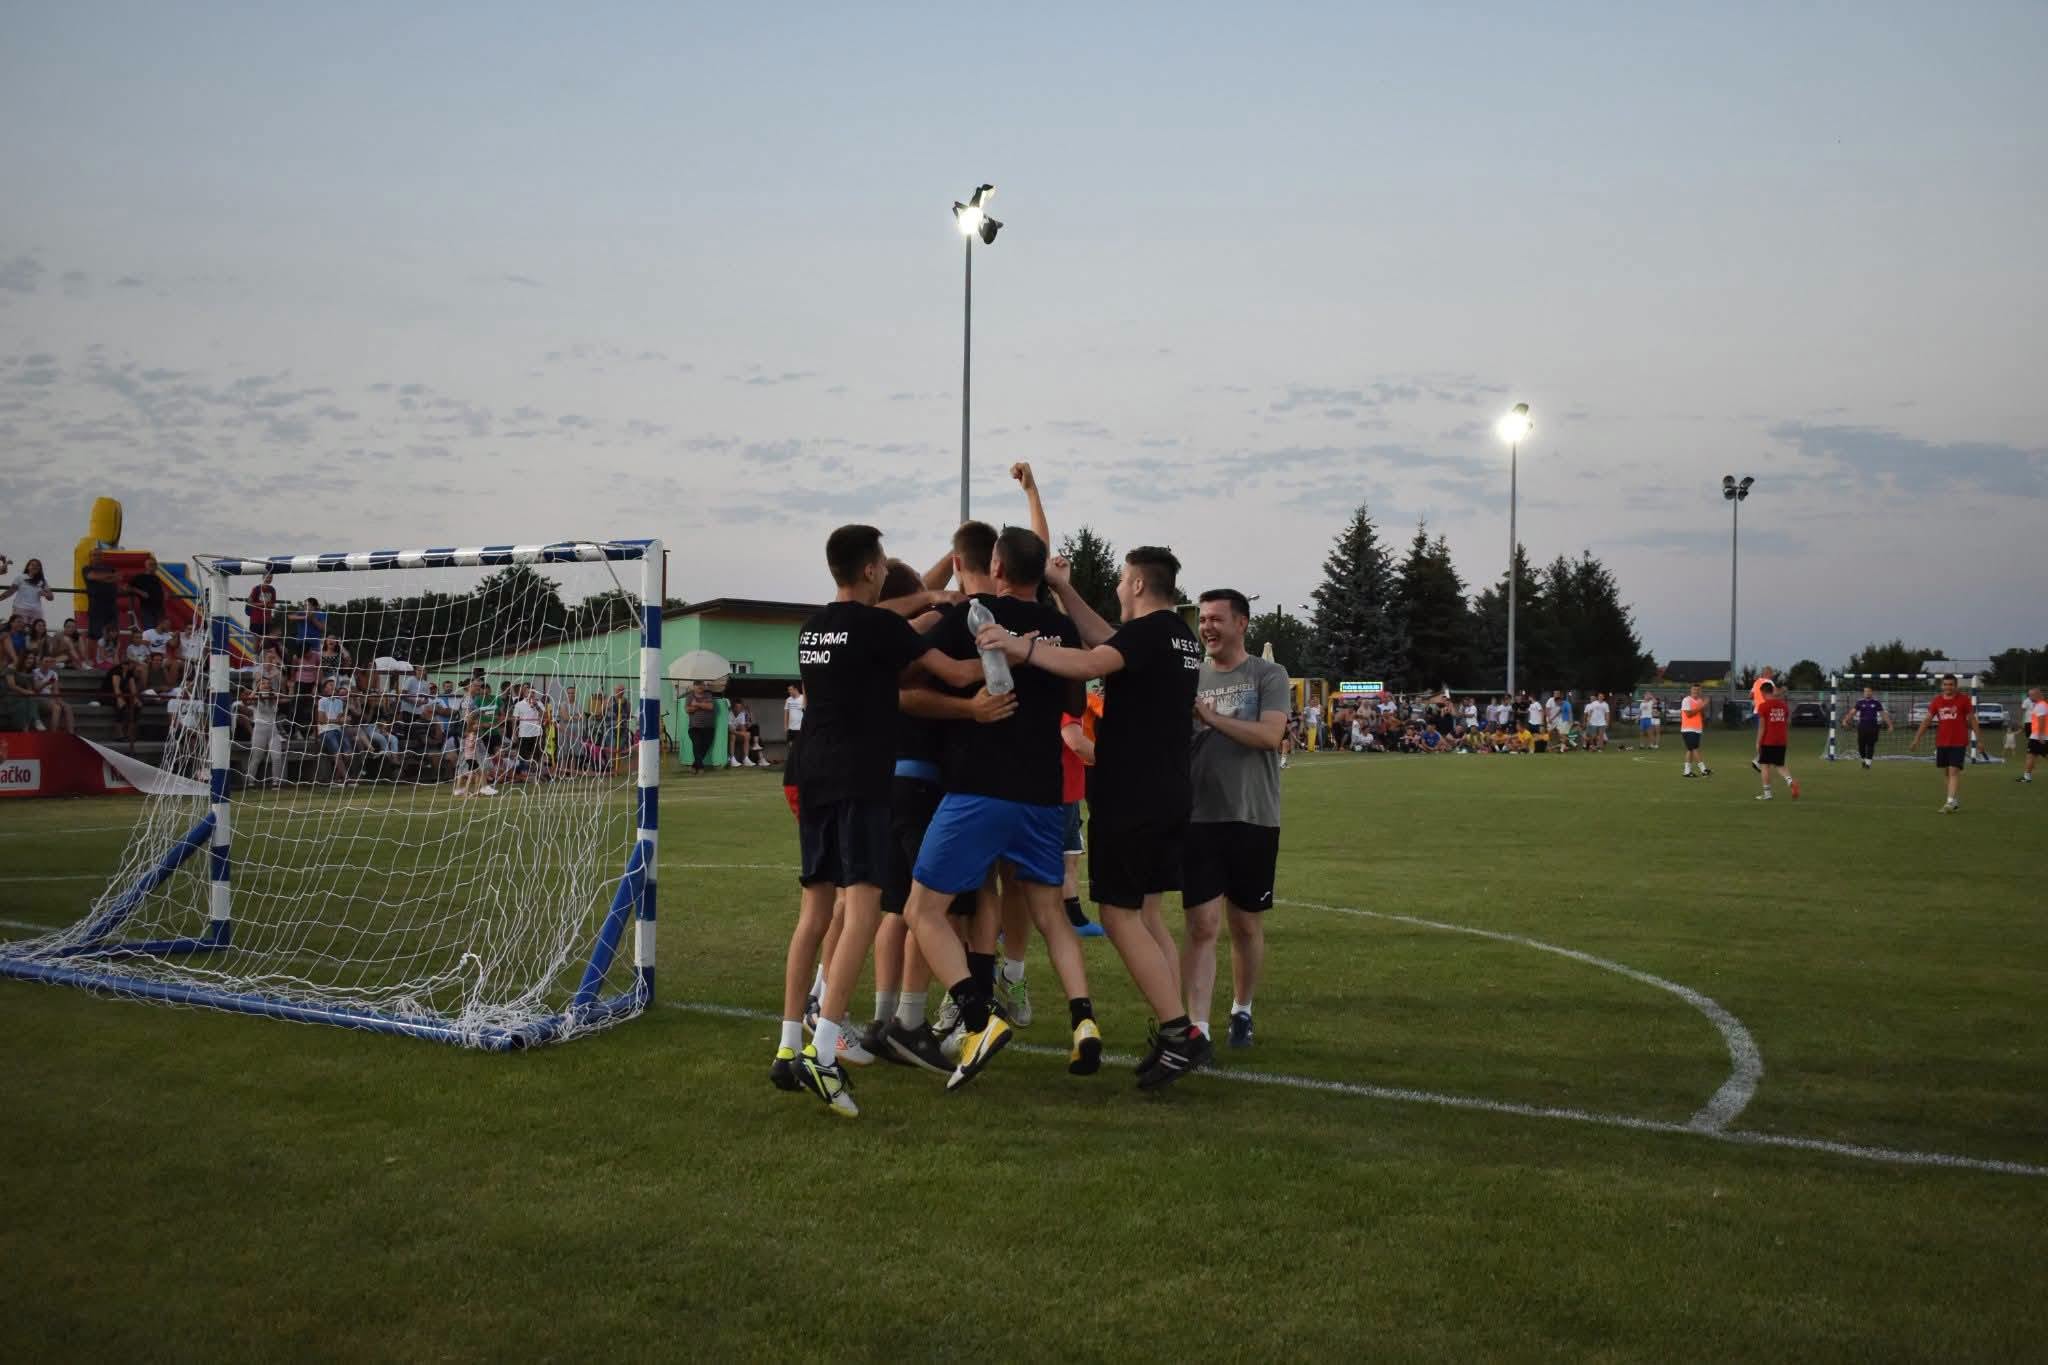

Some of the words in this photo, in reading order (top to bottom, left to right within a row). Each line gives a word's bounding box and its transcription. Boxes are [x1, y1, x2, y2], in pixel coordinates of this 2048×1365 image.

[810, 633, 819, 645] S
[820, 632, 848, 645] VAMA
[0, 766, 31, 783] ačko
